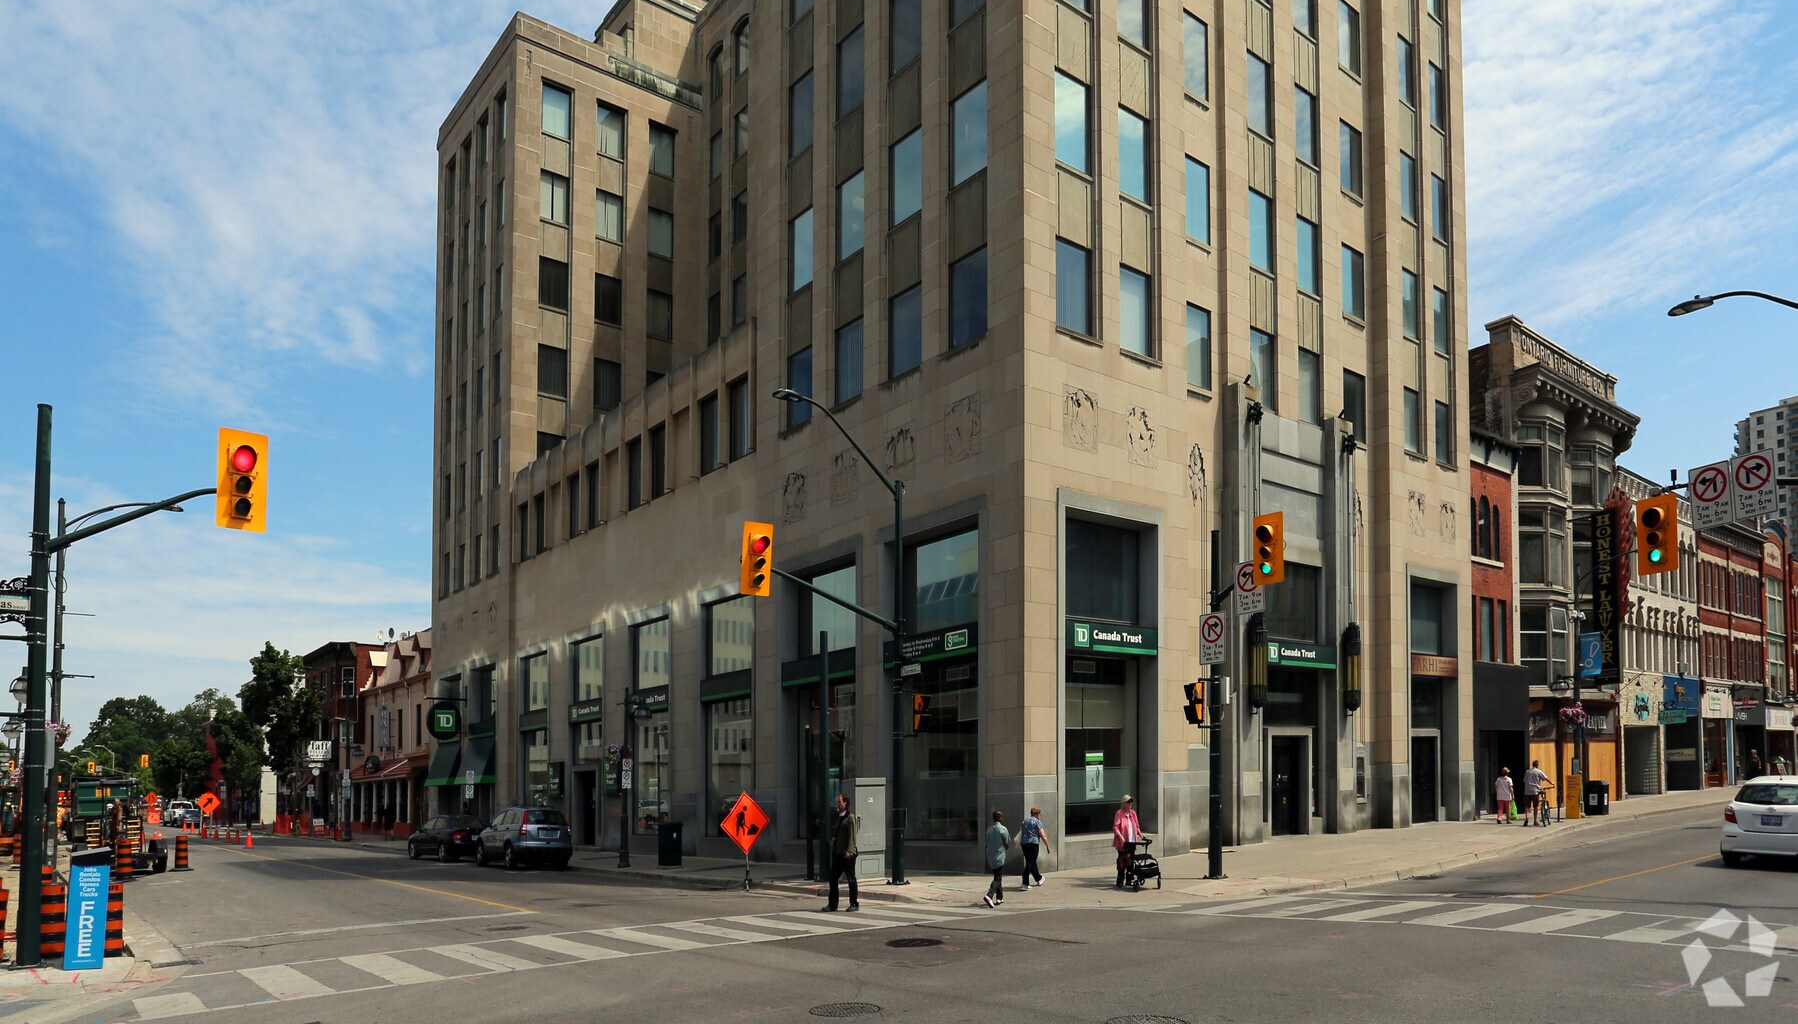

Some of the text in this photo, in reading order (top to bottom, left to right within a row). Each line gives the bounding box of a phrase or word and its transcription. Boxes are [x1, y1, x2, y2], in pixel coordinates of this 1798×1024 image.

[1521, 335, 1551, 365] ONTARIO
[1553, 355, 1591, 388] FURNITURE
[1595, 514, 1612, 585] HONEST
[1598, 590, 1614, 664] LAWYER
[1076, 628, 1142, 644] TD Canada Trust
[1269, 646, 1316, 659] TD Canada Trust
[1412, 657, 1438, 673] FARHI
[654, 694, 666, 703] Trust
[578, 707, 590, 715] Canada
[590, 705, 600, 713] Trust
[437, 714, 453, 727] TD
[77, 900, 95, 957] FREE
